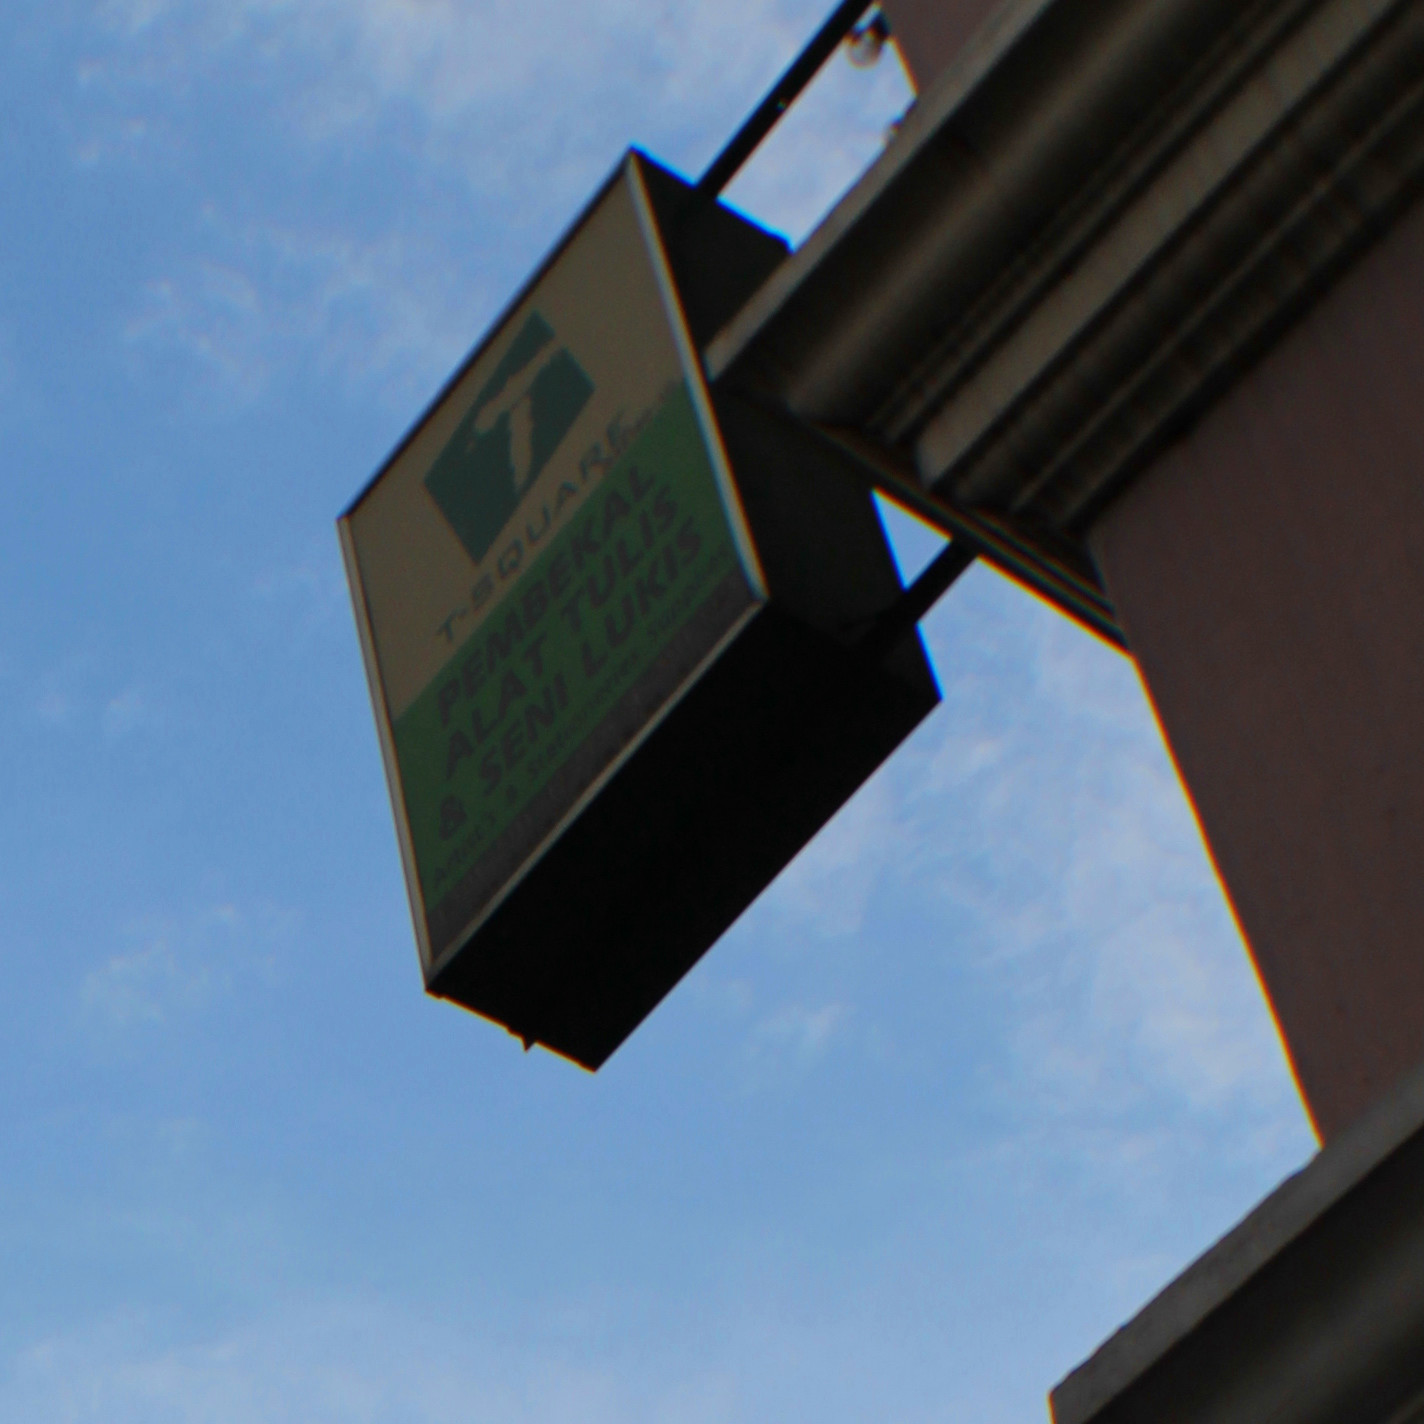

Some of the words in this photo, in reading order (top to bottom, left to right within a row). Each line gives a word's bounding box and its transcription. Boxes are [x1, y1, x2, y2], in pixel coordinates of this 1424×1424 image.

[437, 792, 469, 843] &
[479, 670, 571, 798] SENI
[581, 514, 707, 681] LUKIS
[438, 464, 657, 727] PEMBEKAL
[444, 633, 553, 780] ALAT
[559, 486, 682, 644] TULIS
